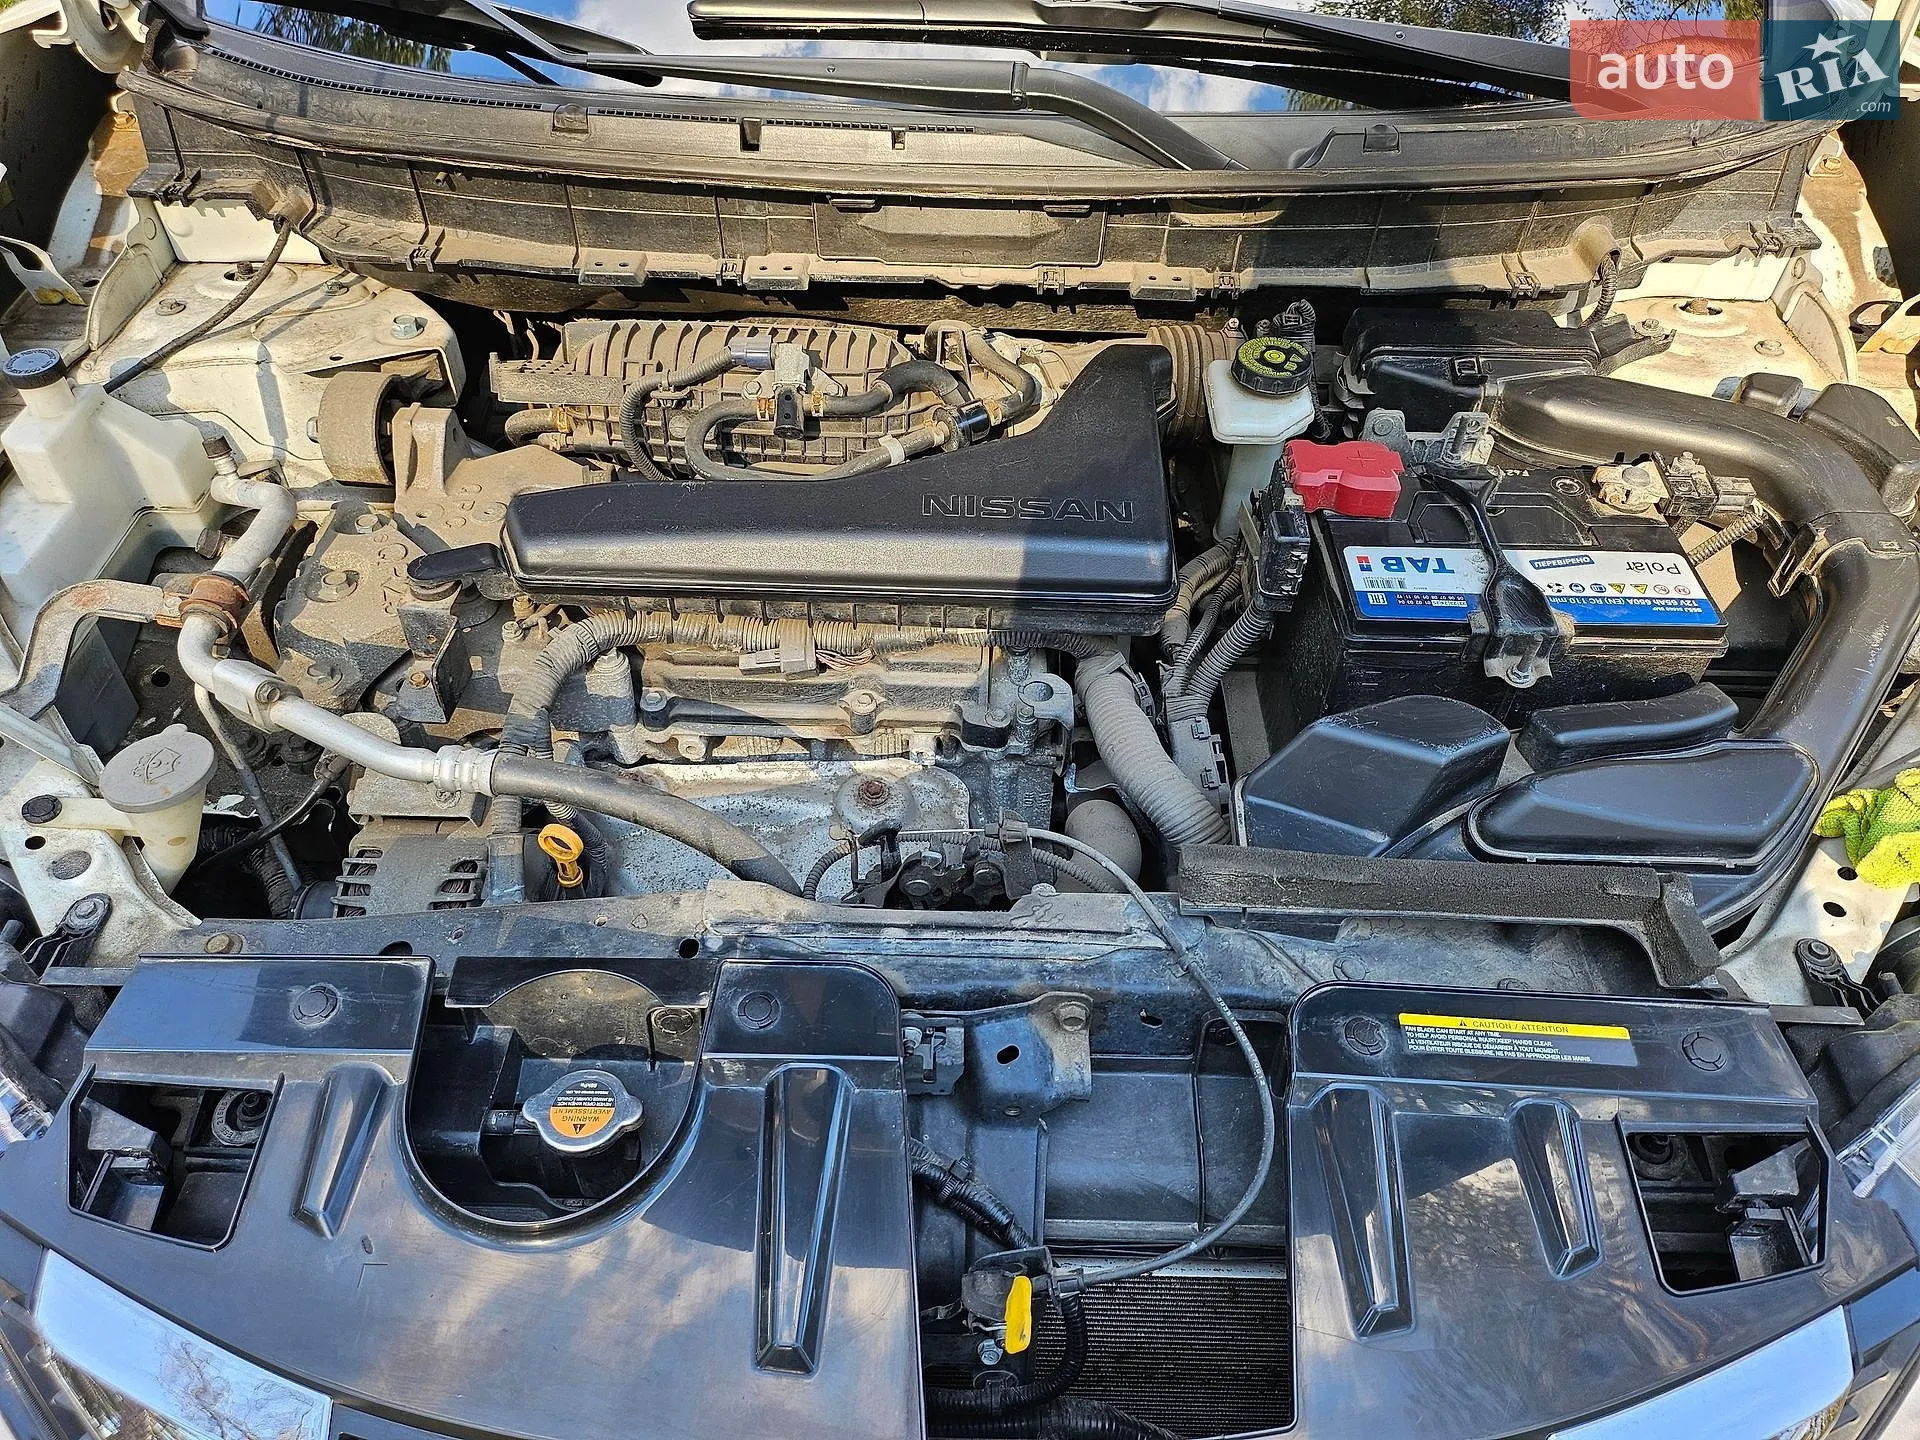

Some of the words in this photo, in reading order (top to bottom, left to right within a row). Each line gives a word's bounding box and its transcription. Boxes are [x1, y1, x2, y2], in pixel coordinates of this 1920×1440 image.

[921, 494, 1133, 524] NISSAN
[1380, 556, 1456, 574] TAB
[1534, 556, 1590, 568] ПЕРЕВІРЕНО
[1625, 560, 1681, 575] Polar
[1604, 597, 1625, 606] (EN)
[1626, 598, 1651, 606] 650A
[1652, 599, 1678, 607] 65Ah
[1472, 1020, 1511, 1030] CAUTION
[1521, 1024, 1569, 1033] ATTENTION
